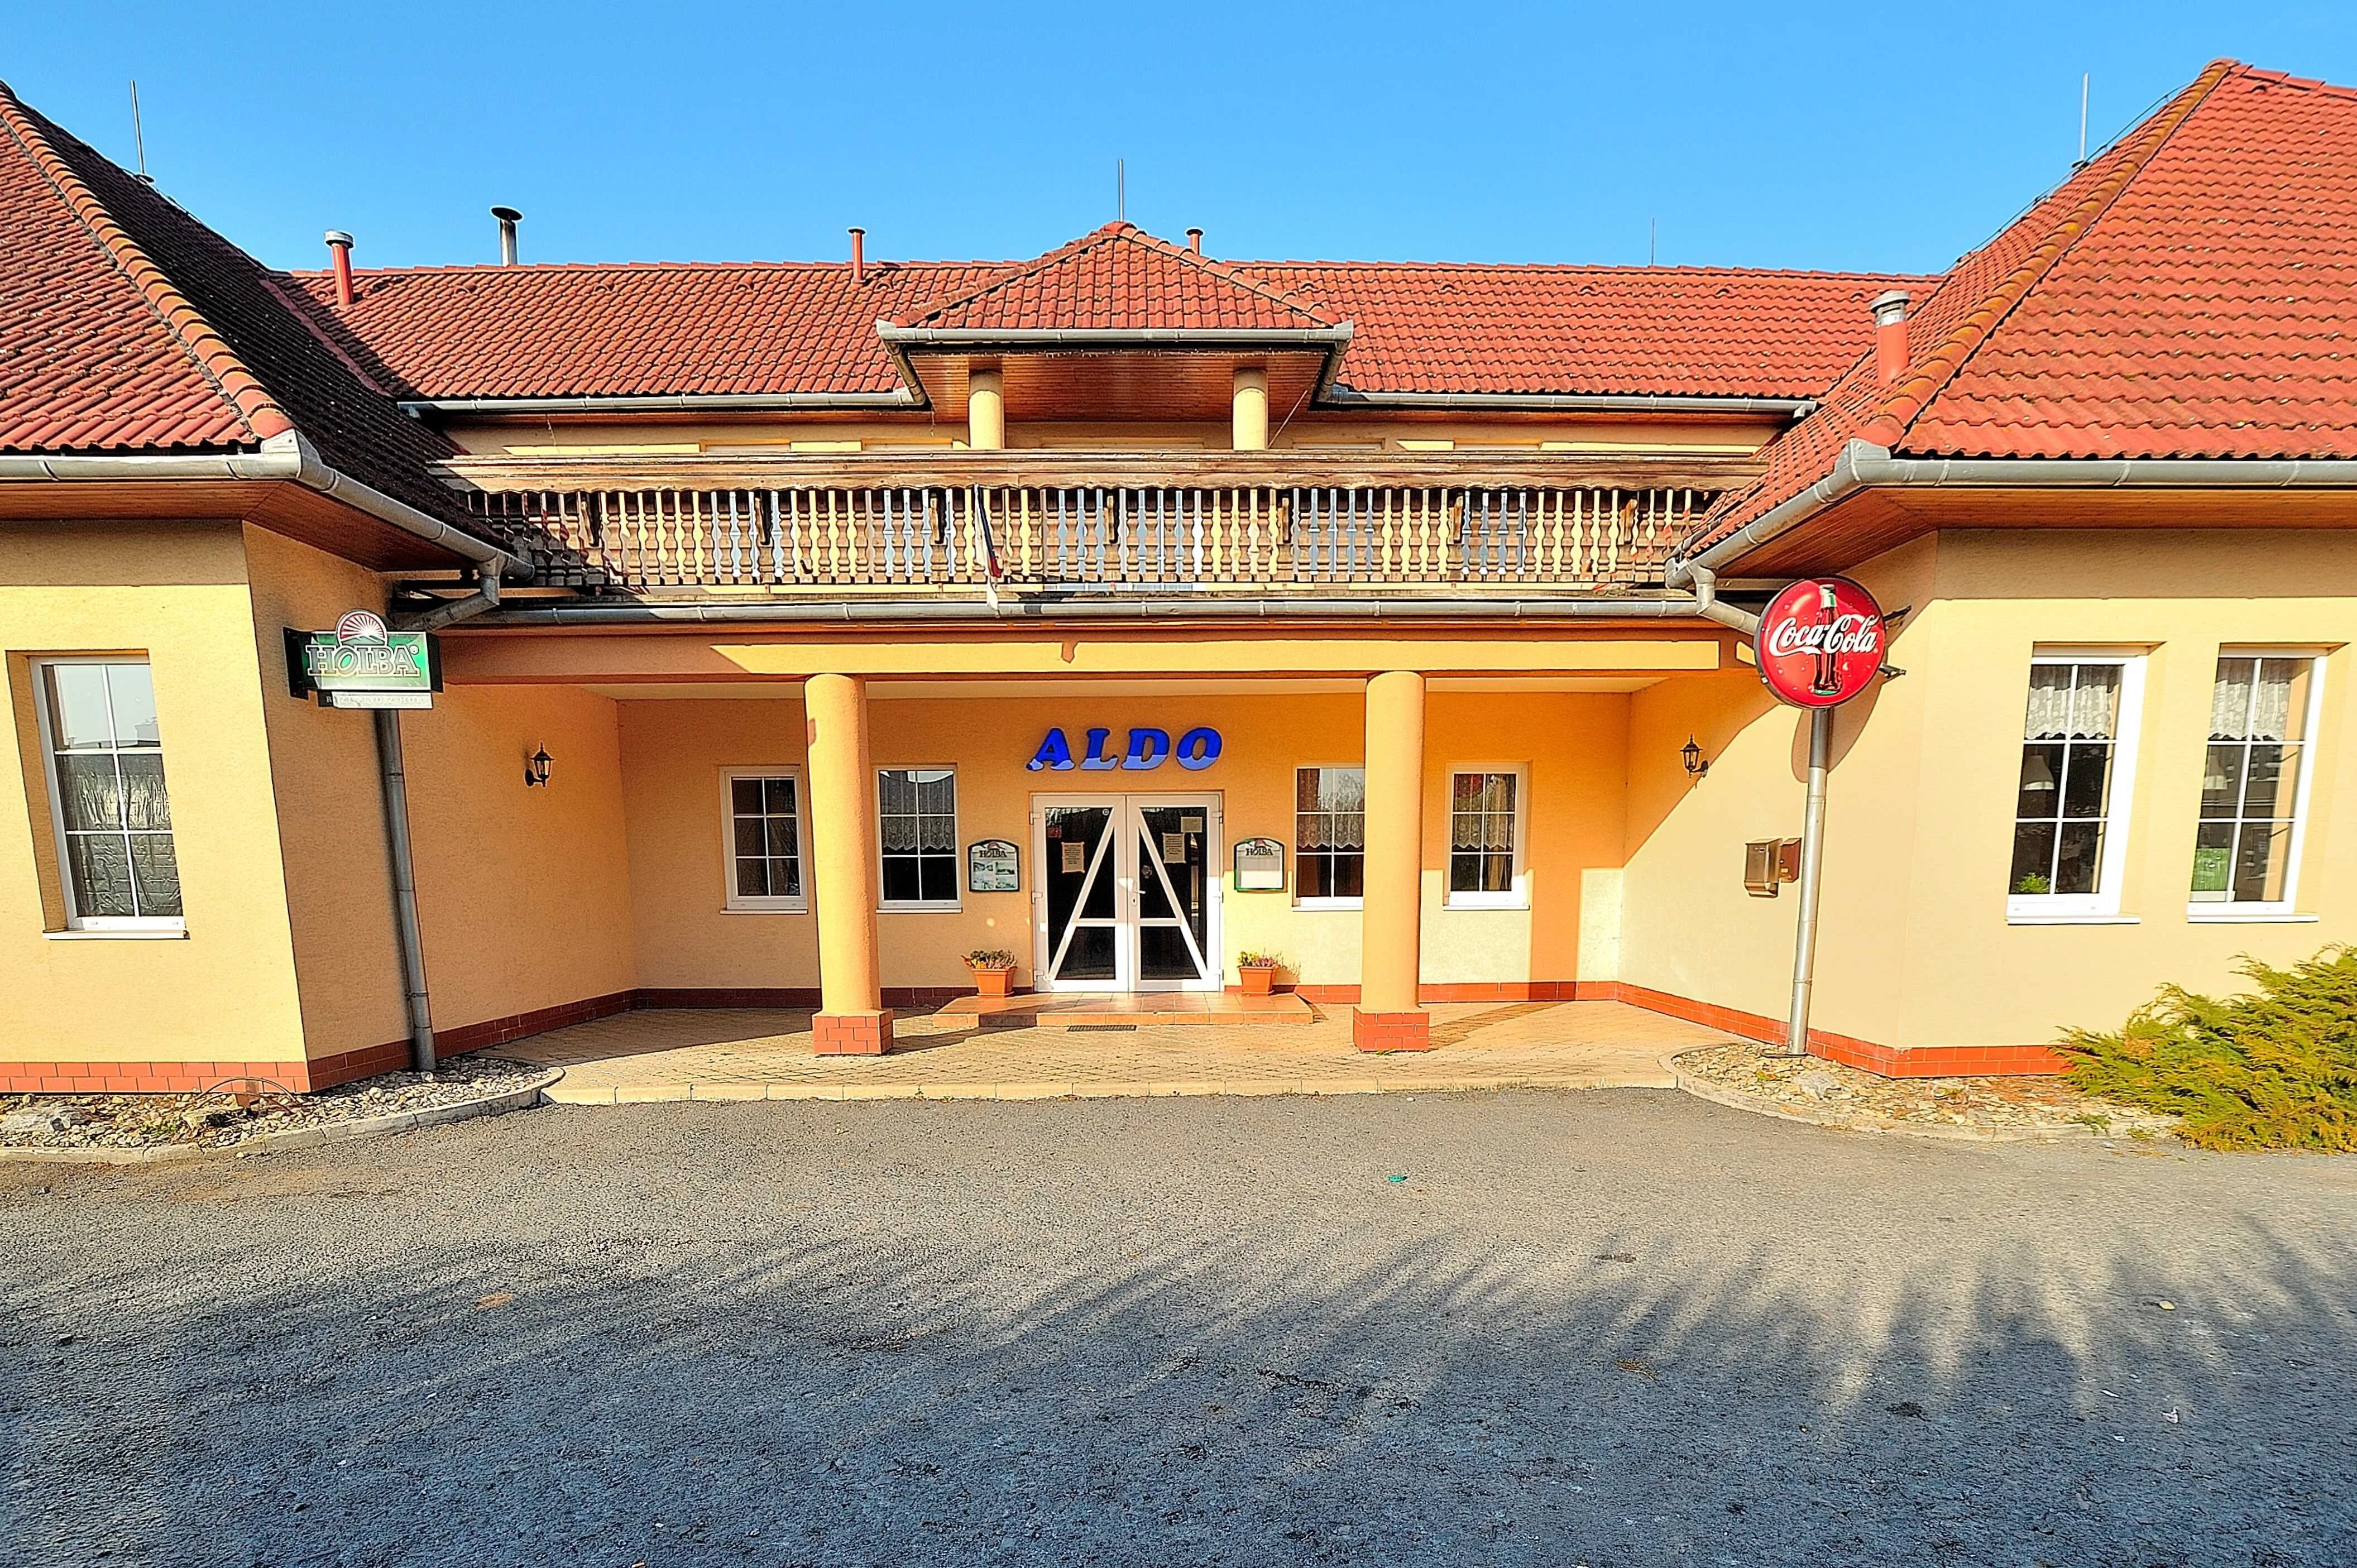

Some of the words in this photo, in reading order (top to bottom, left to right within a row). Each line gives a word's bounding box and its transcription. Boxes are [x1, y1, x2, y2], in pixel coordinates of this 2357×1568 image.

[1769, 613, 1880, 656] Coca-Cola
[305, 645, 420, 676] HOLBA
[1026, 727, 1223, 771] ALDO
[1245, 848, 1273, 856] HOLBA
